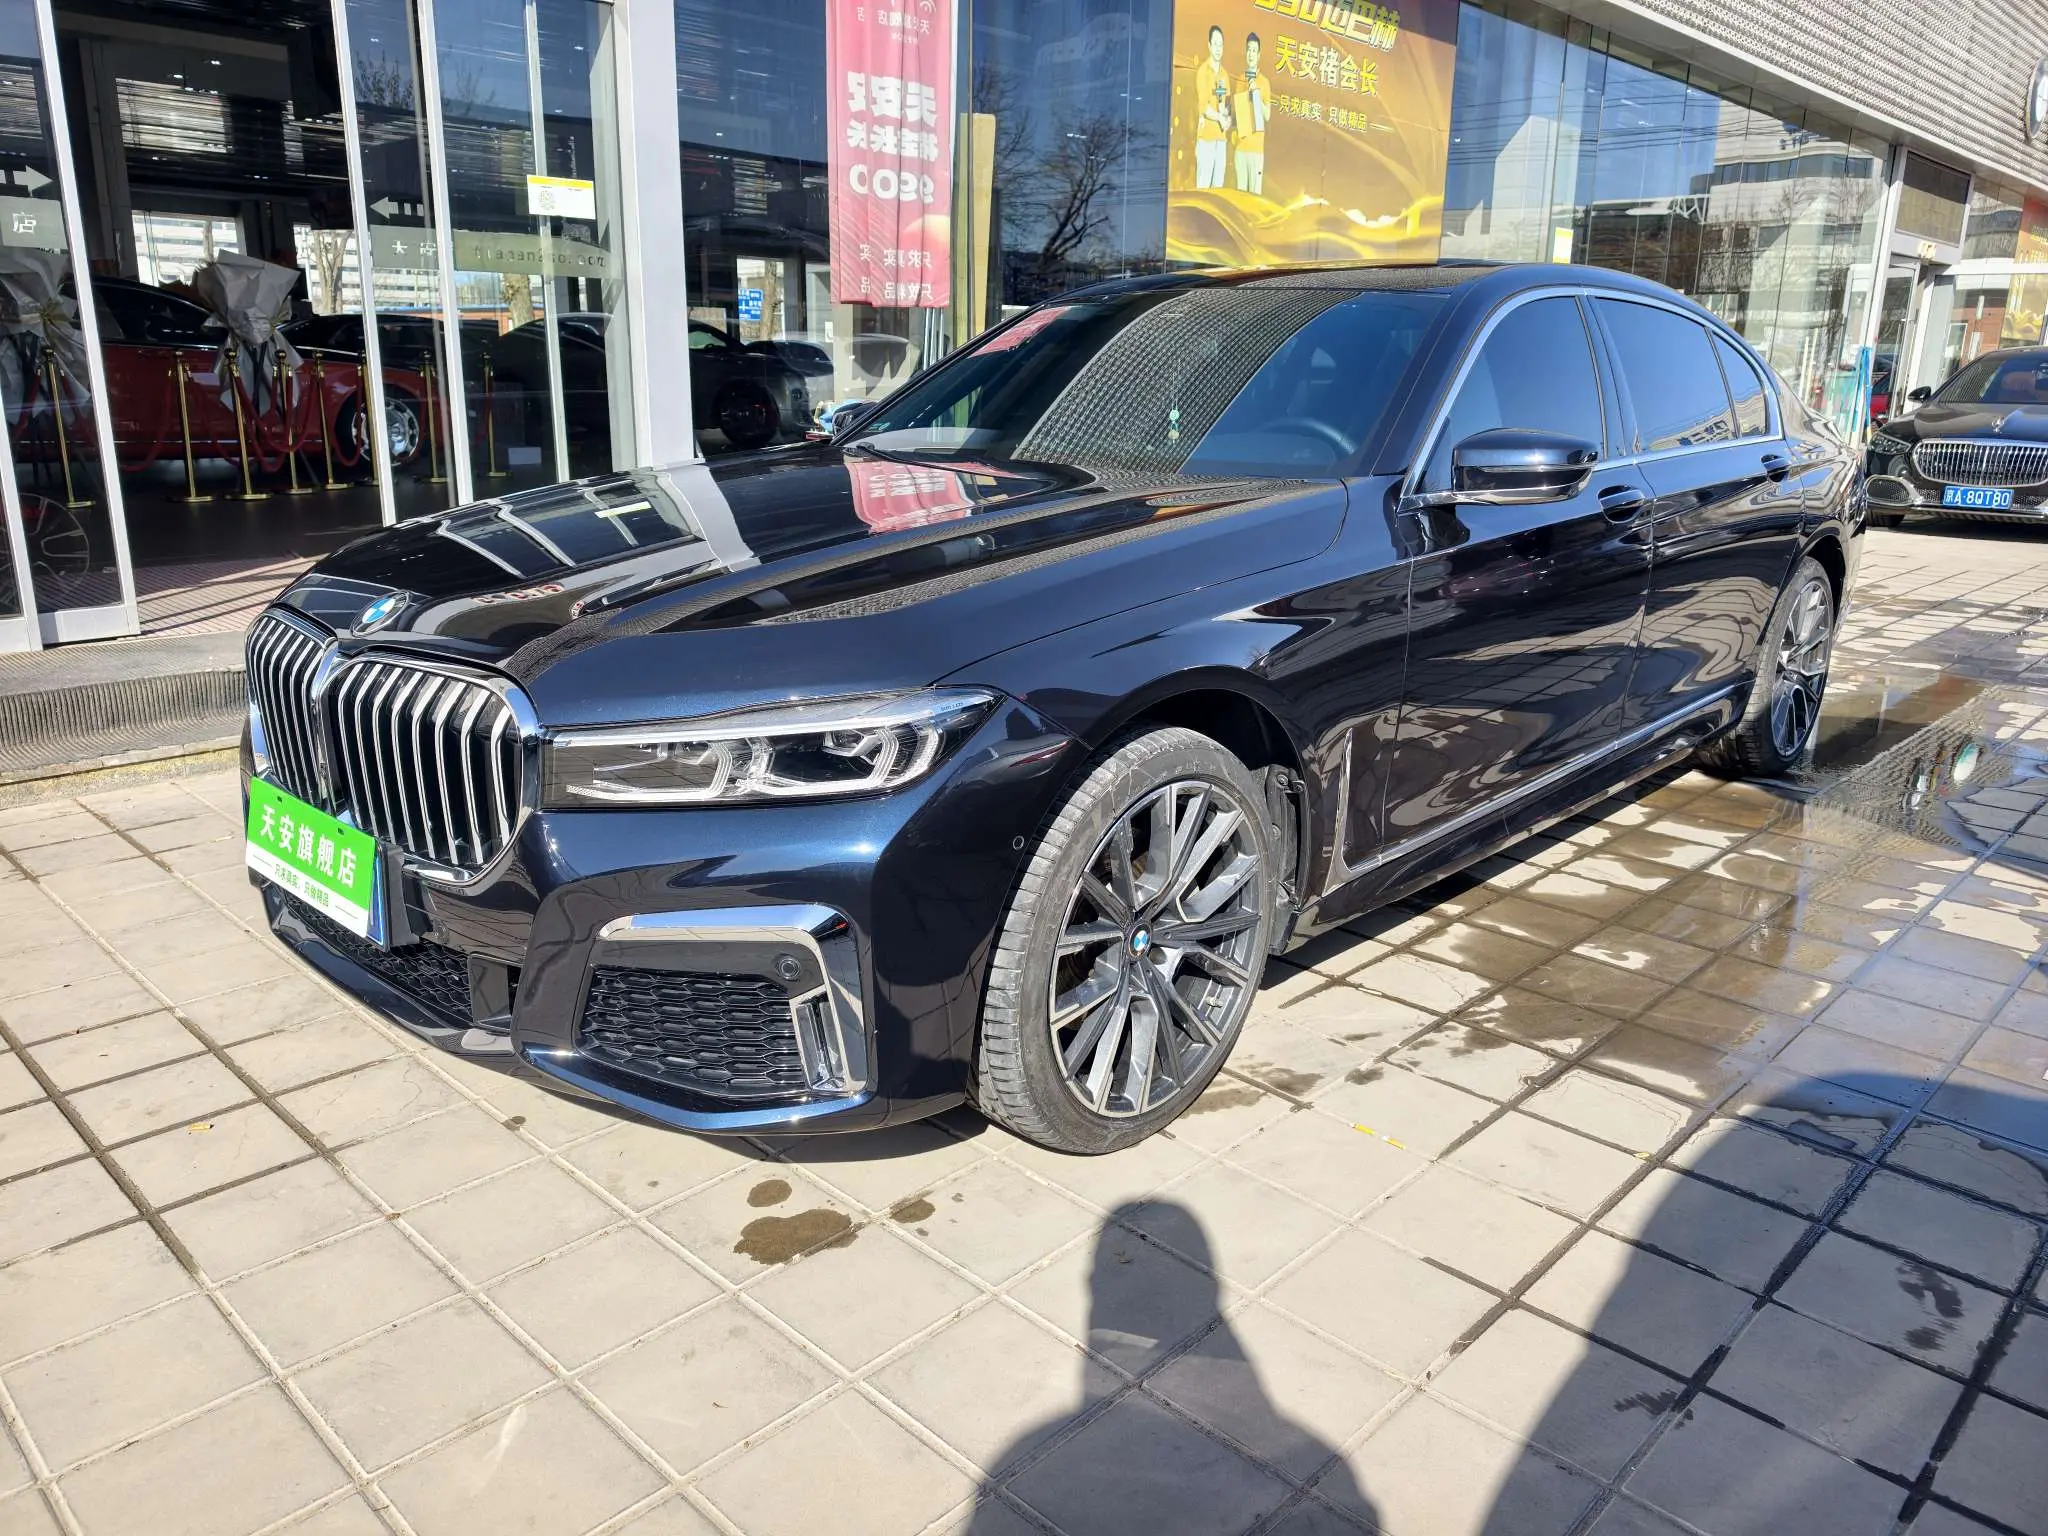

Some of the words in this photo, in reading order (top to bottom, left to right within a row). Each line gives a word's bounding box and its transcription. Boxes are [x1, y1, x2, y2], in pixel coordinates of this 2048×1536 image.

[260, 803, 357, 889] 天安旗舰店
